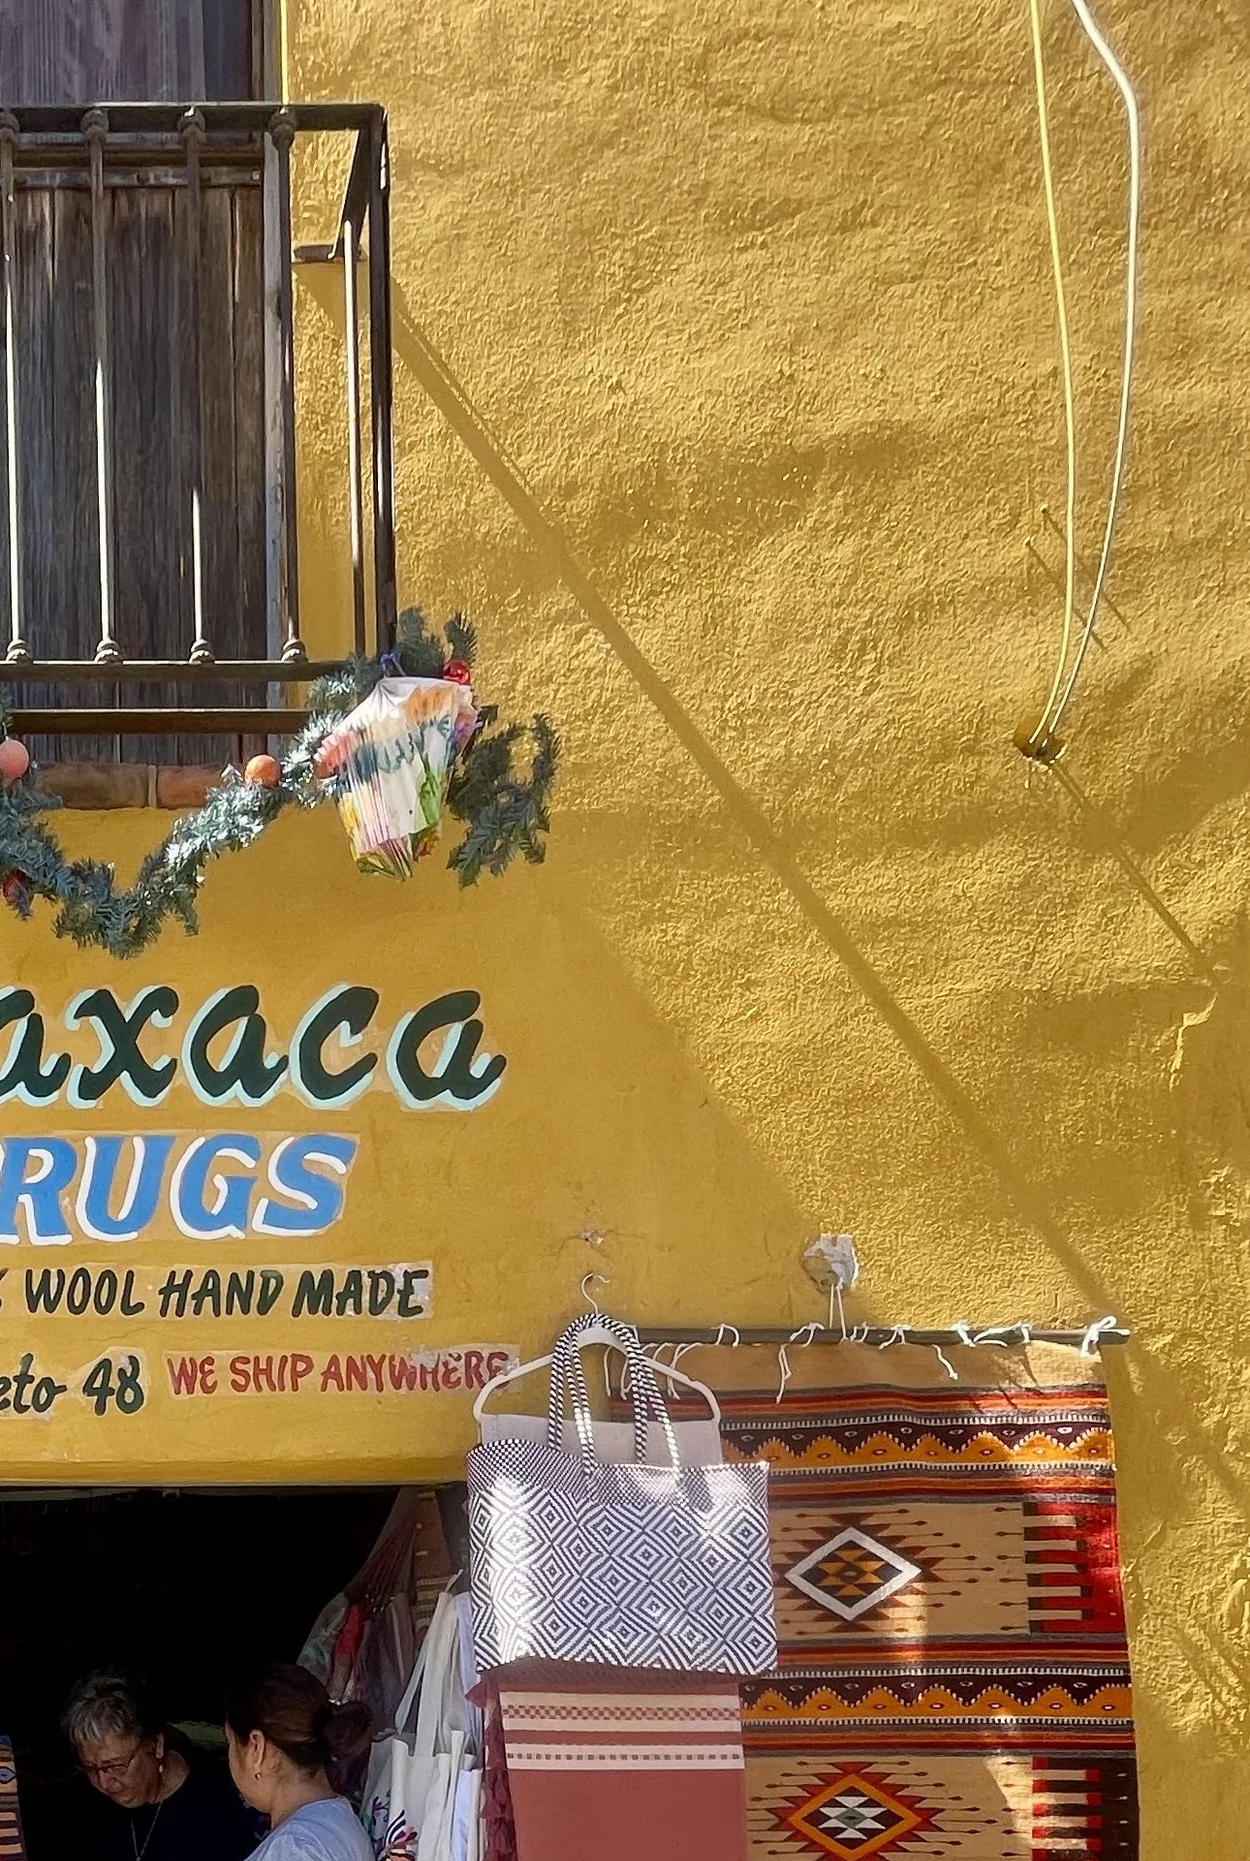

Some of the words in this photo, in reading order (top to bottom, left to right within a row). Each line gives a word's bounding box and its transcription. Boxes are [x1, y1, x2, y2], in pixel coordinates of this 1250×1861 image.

[25, 1268, 145, 1316] WOOL
[158, 1269, 282, 1317] HAND
[291, 1268, 430, 1317] MADE
[82, 1358, 144, 1416] 48
[167, 1357, 218, 1395] WE
[230, 1355, 314, 1394] SHIP
[321, 1353, 511, 1394] ANYWHERE
